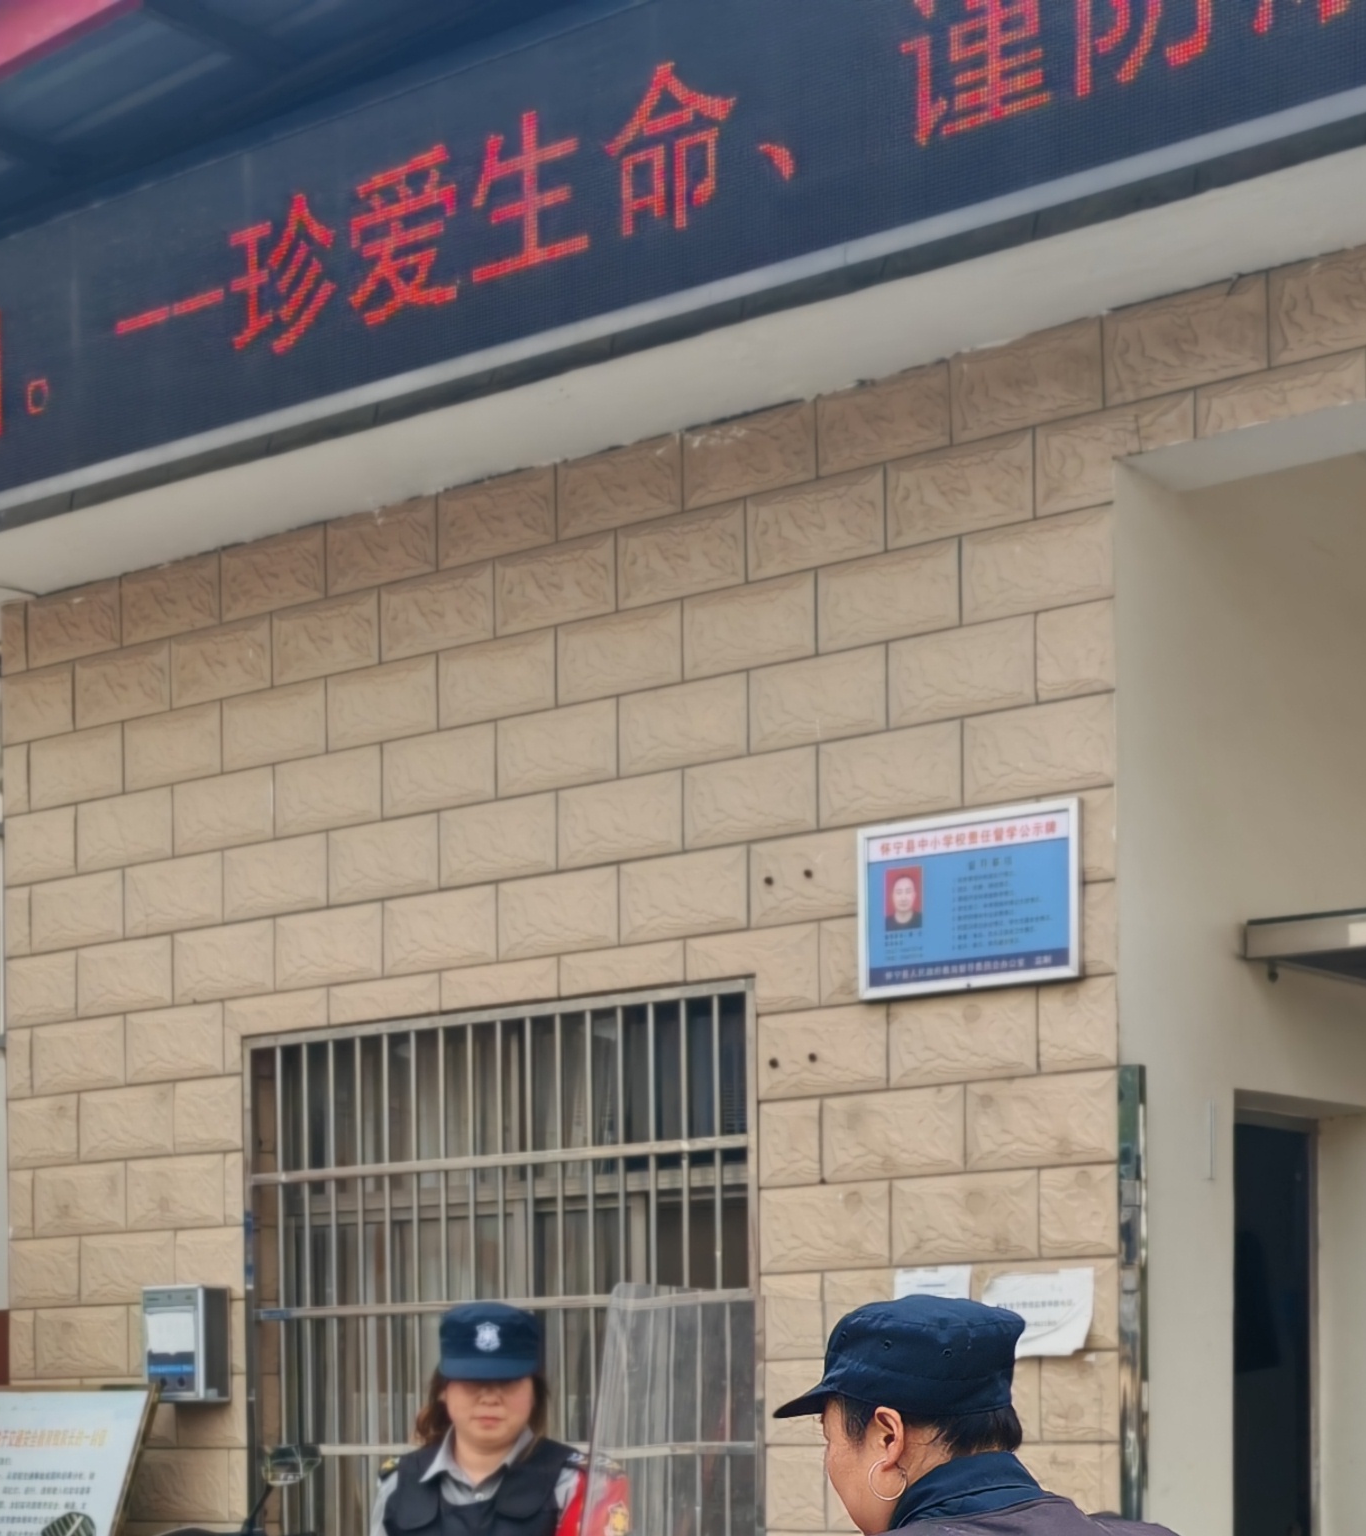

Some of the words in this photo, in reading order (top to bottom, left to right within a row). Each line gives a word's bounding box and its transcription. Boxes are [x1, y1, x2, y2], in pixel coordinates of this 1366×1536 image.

[879, 820, 1057, 856] 怀宁县中小学校责任督学公示牌
